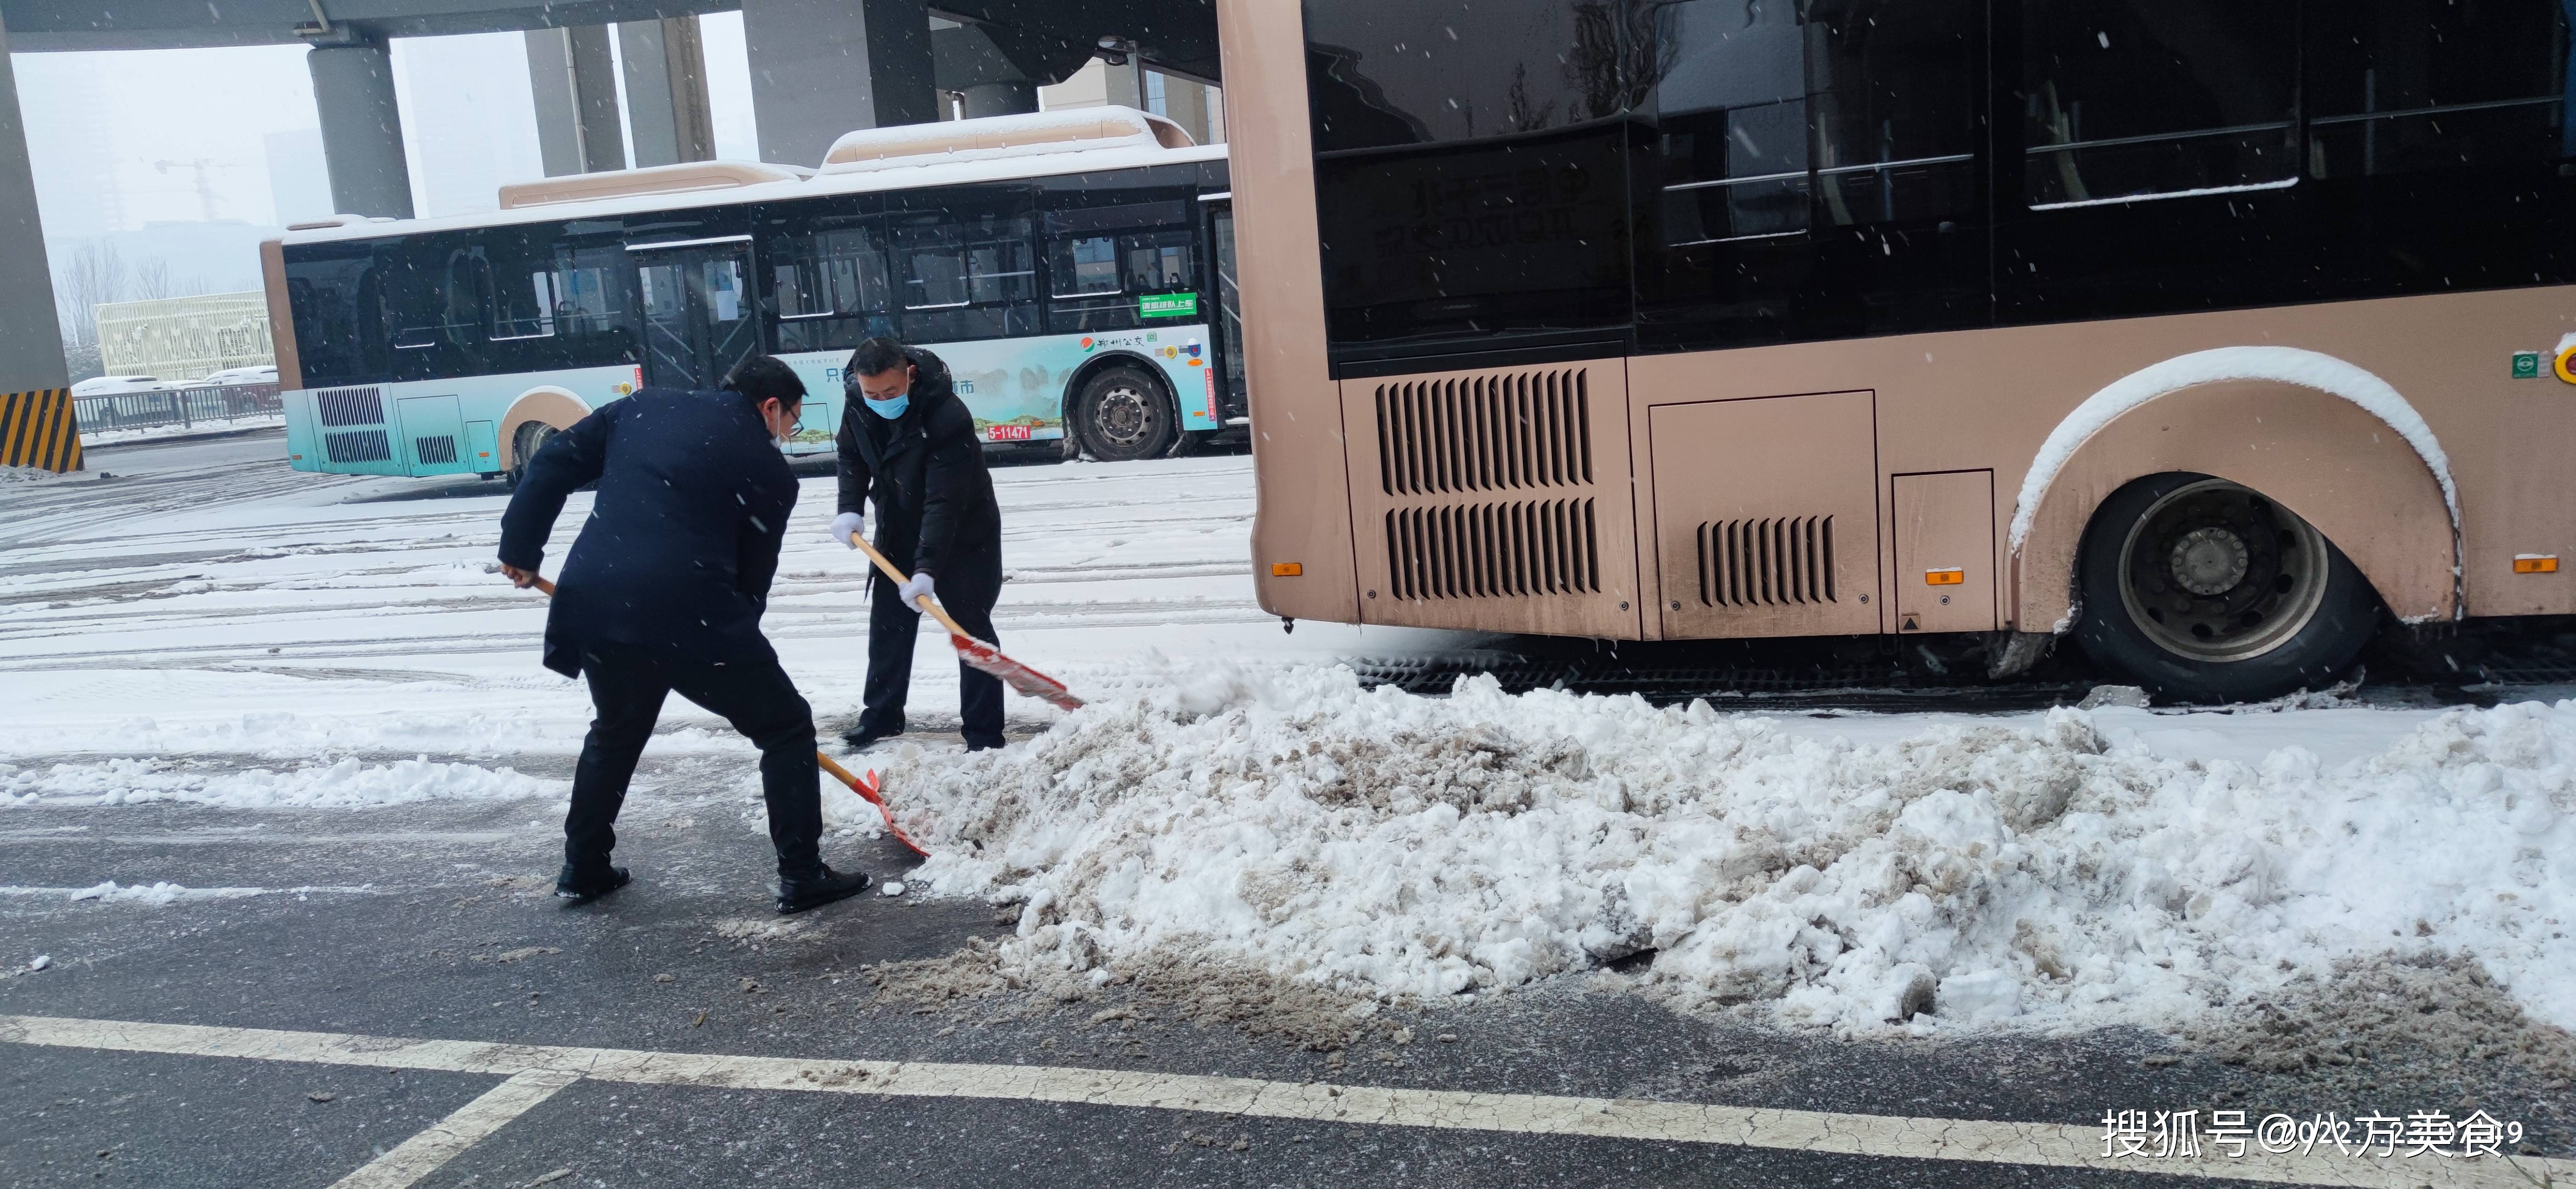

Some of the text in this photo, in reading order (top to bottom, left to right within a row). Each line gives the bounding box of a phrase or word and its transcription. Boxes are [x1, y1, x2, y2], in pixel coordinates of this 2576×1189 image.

[1097, 336, 1145, 349] 郑州公交
[783, 357, 840, 366] 化全国文明城市创建
[989, 426, 1028, 439] 5-11471
